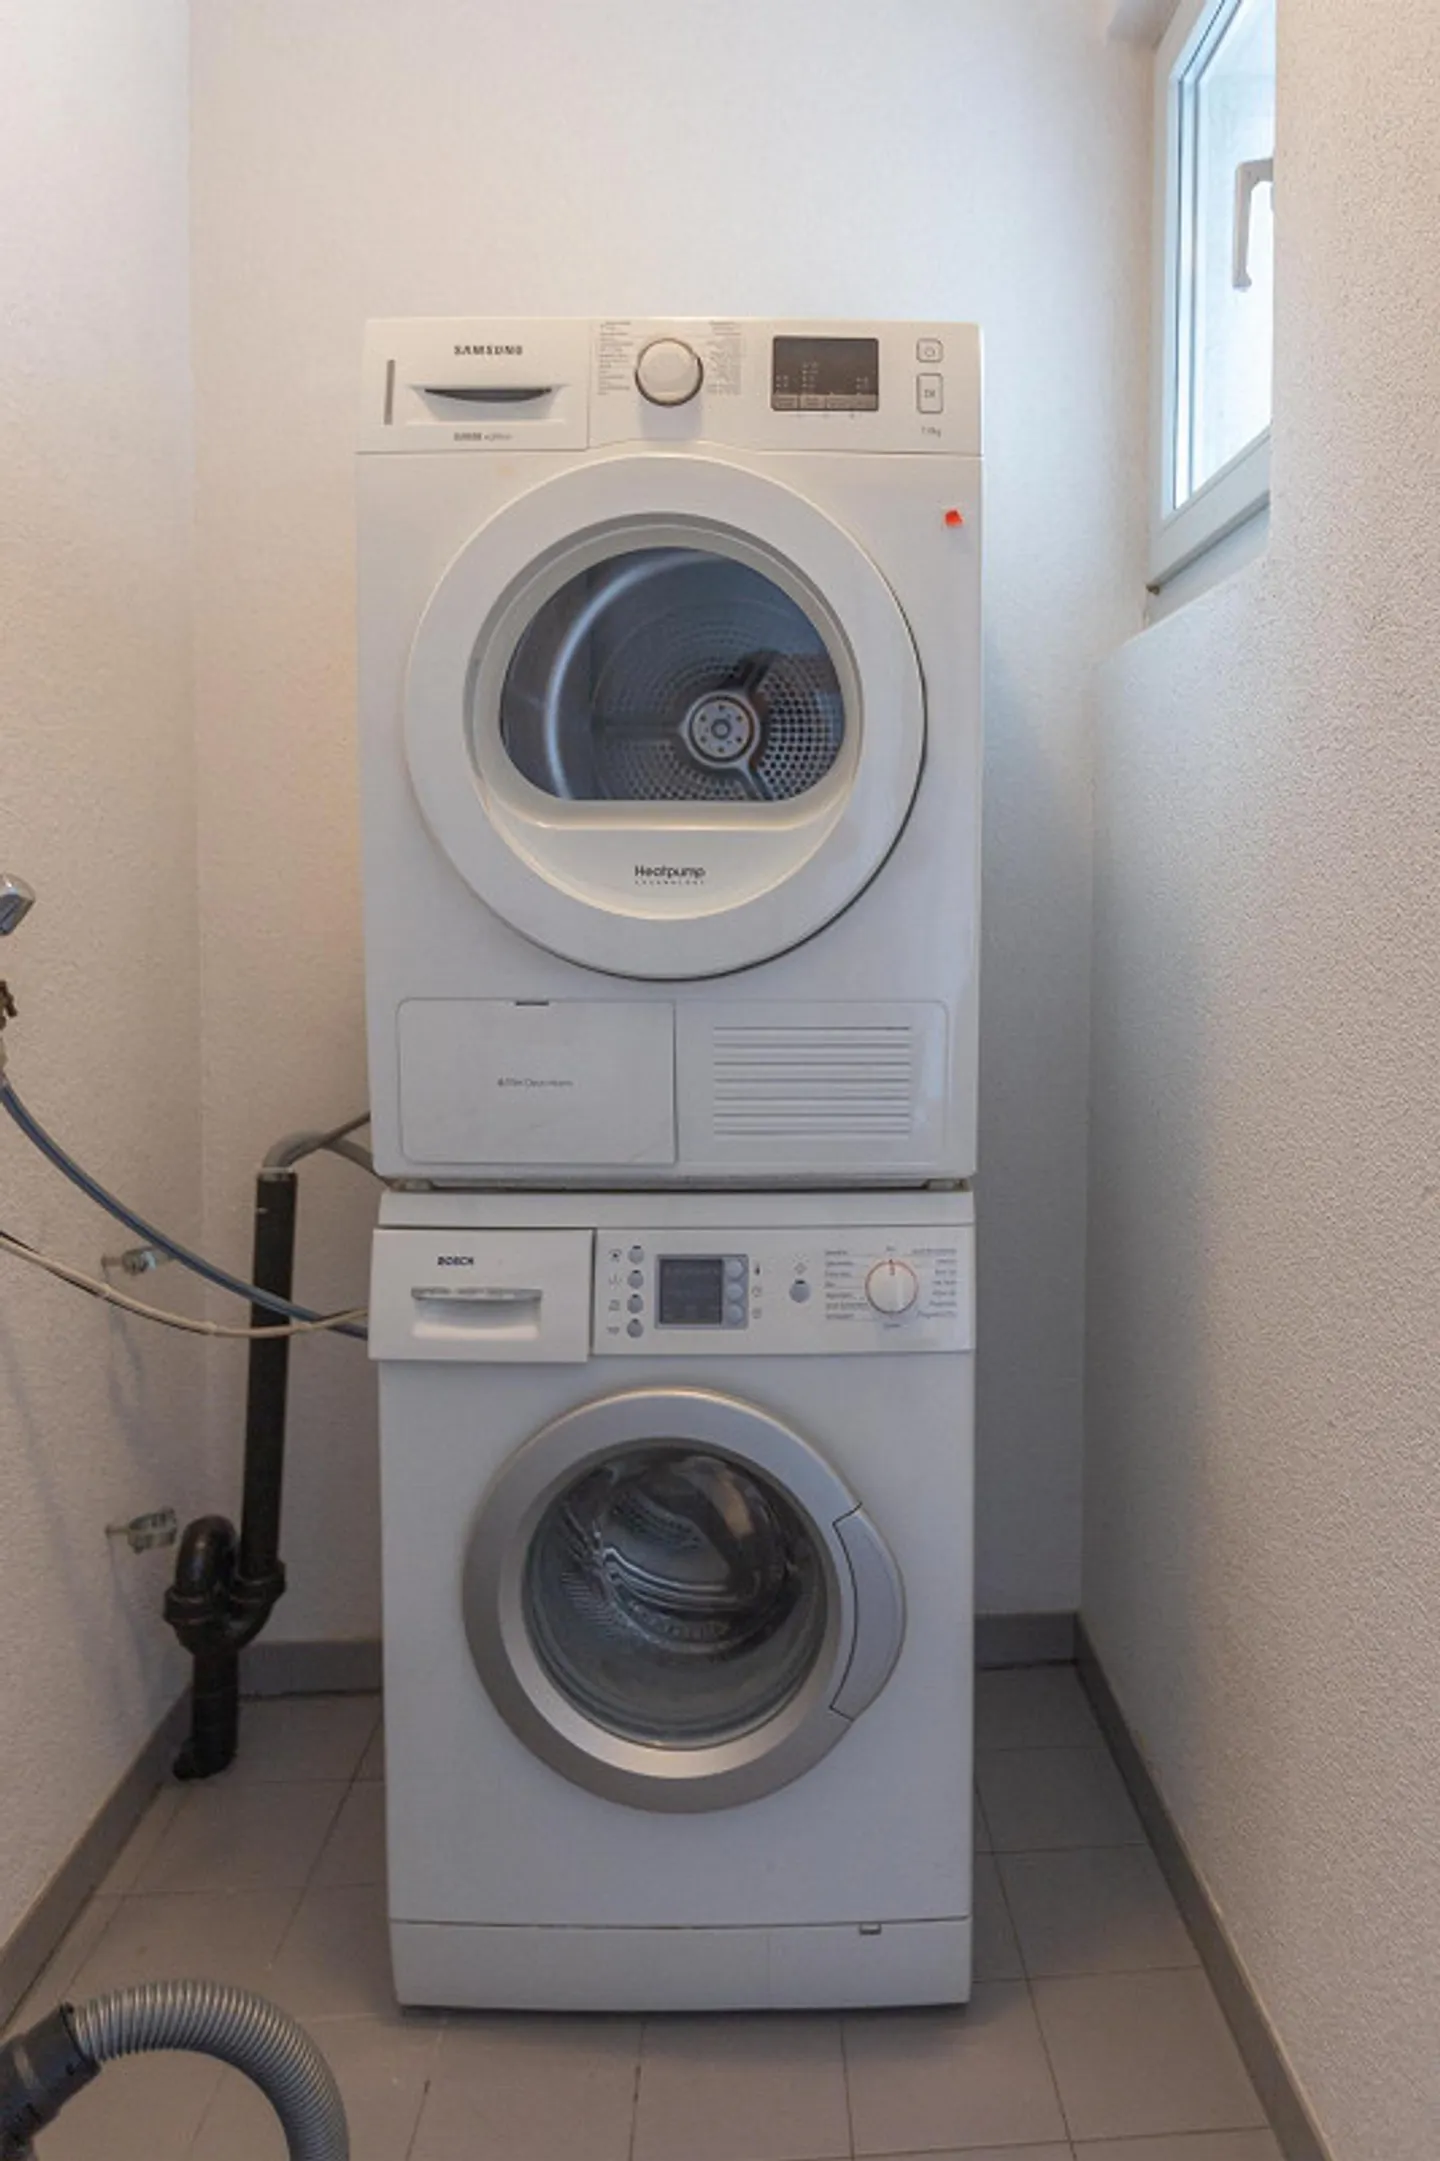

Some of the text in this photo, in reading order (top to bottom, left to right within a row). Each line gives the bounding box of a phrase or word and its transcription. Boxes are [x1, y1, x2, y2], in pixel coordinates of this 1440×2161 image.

[453, 344, 524, 356] SAMSUNG
[634, 865, 707, 879] Heatpump
[437, 1256, 475, 1266] BOSCH
